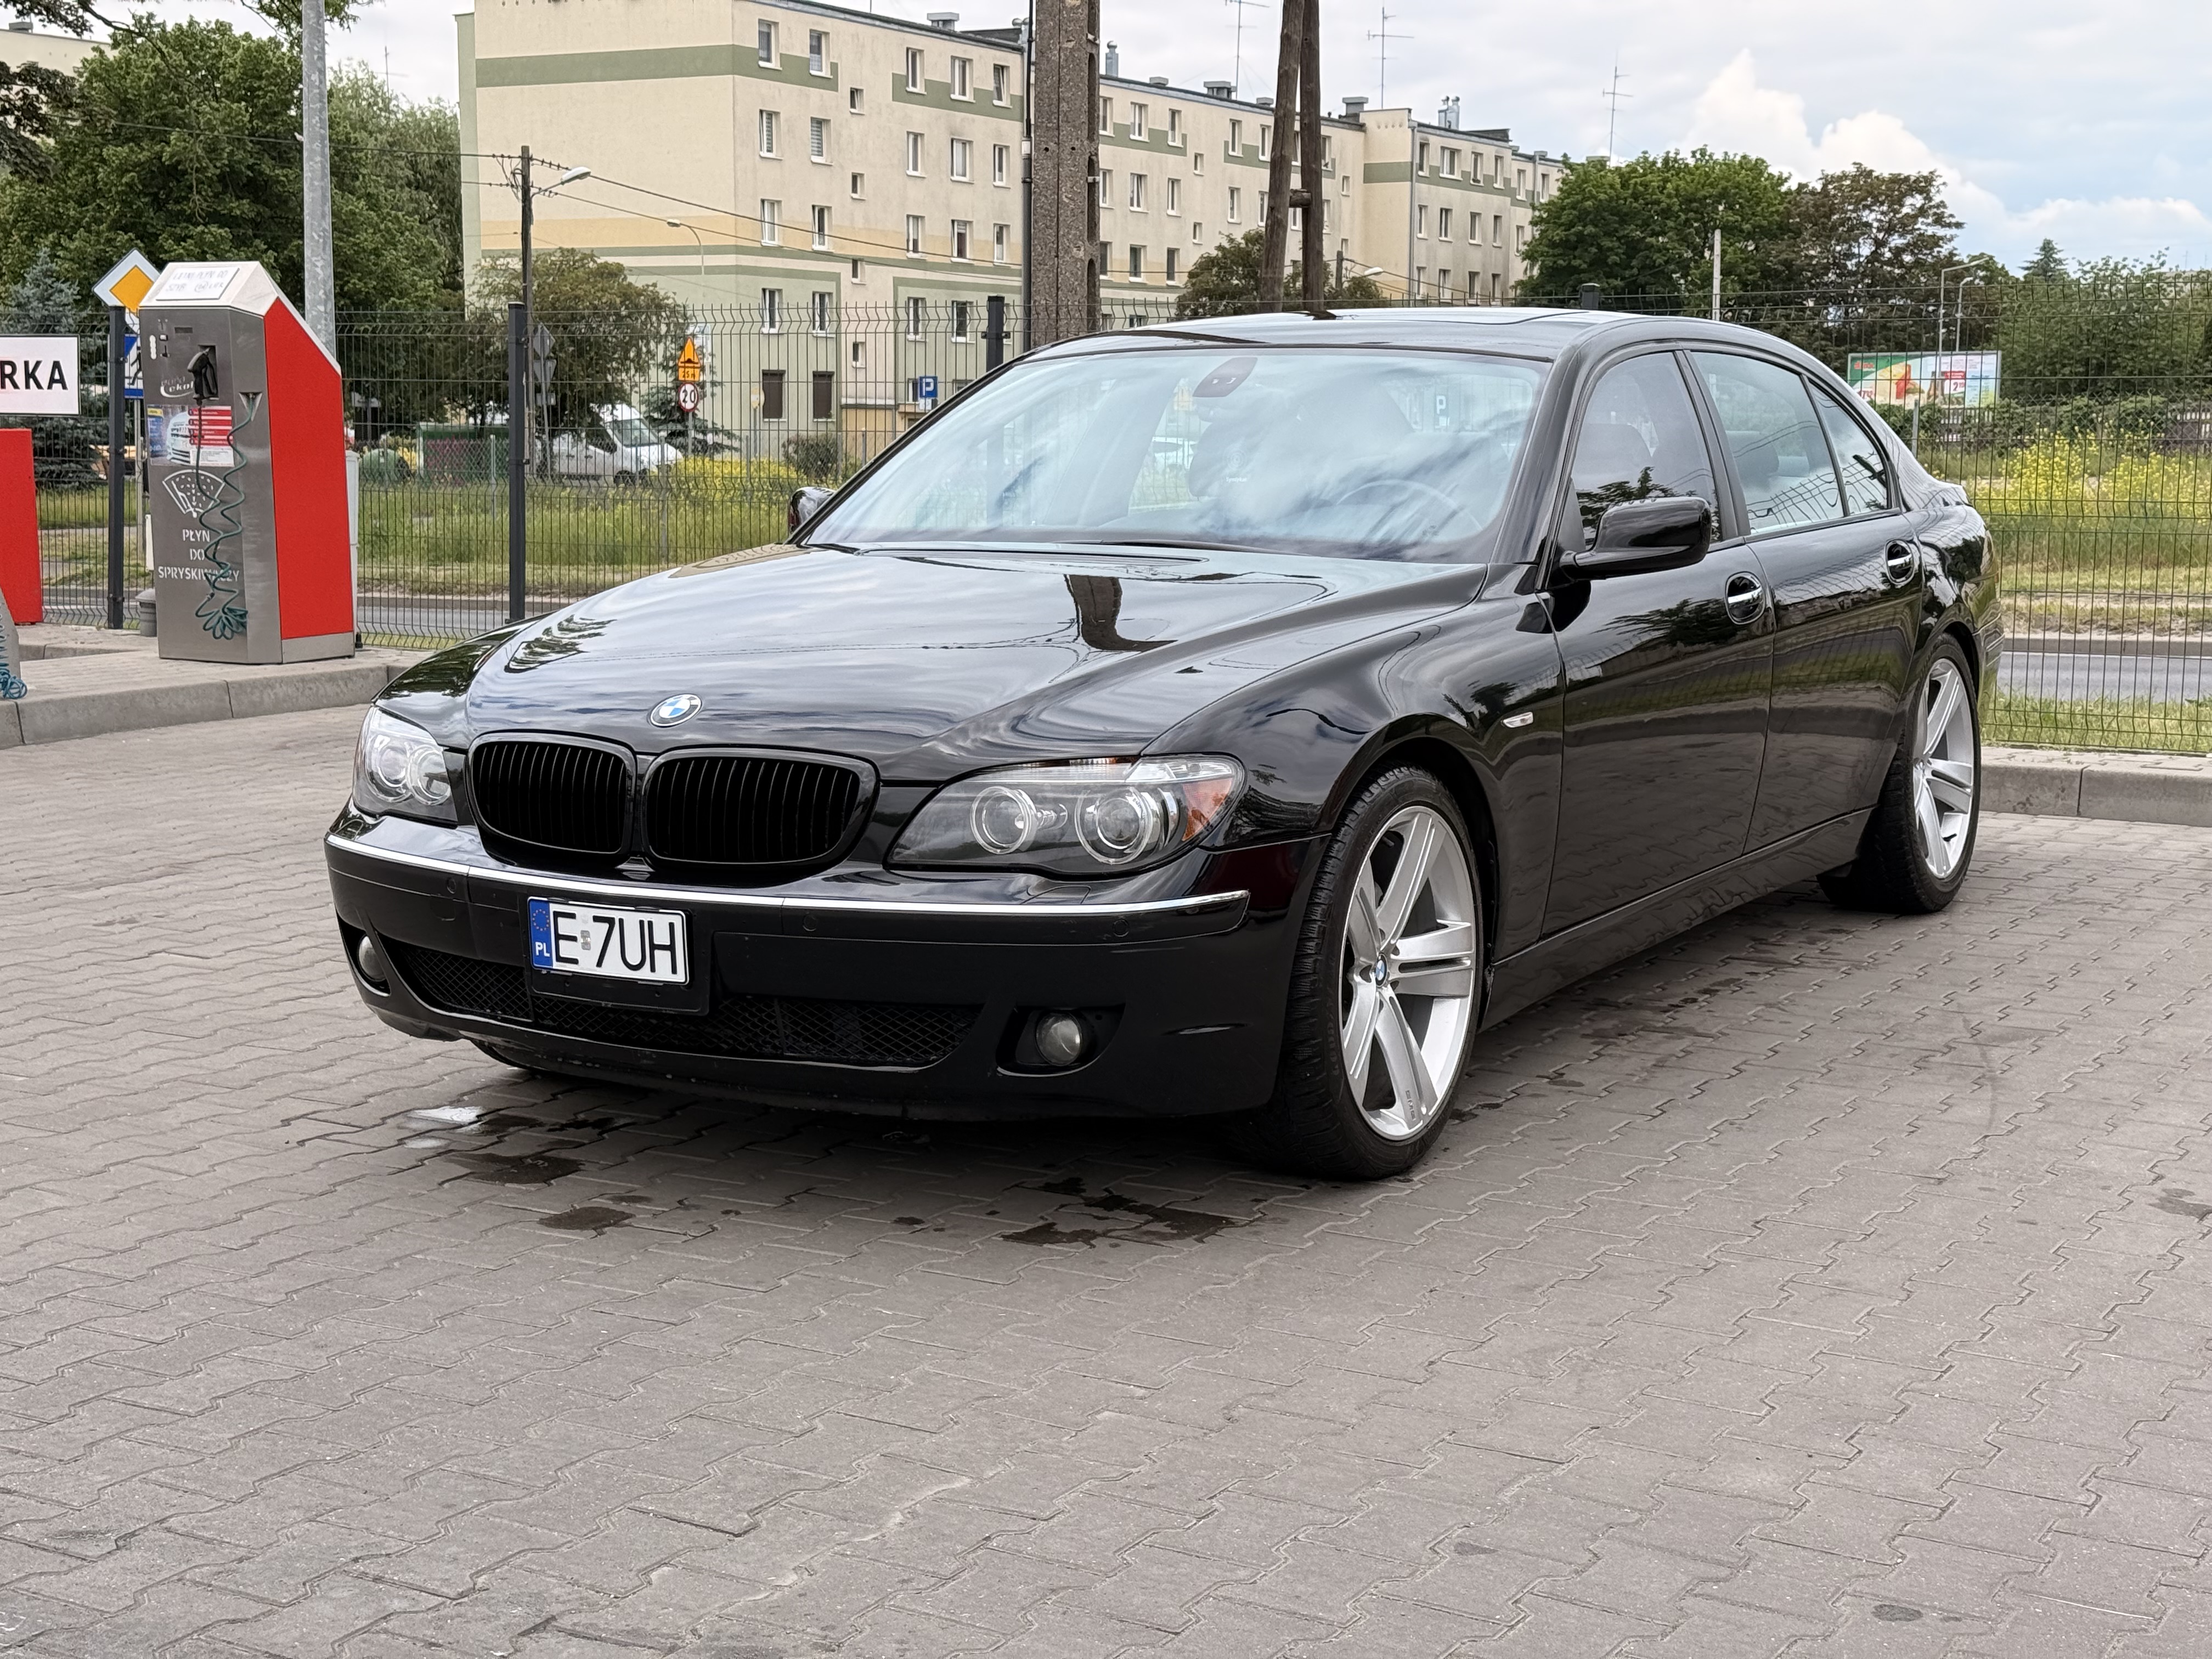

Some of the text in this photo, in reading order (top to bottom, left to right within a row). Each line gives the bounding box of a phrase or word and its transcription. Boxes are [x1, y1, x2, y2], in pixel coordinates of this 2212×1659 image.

[0, 360, 68, 390] RKA
[923, 378, 934, 396] P
[682, 389, 696, 404] 20
[183, 529, 210, 542] PŁYN
[190, 549, 205, 560] DO
[535, 942, 550, 957] PL
